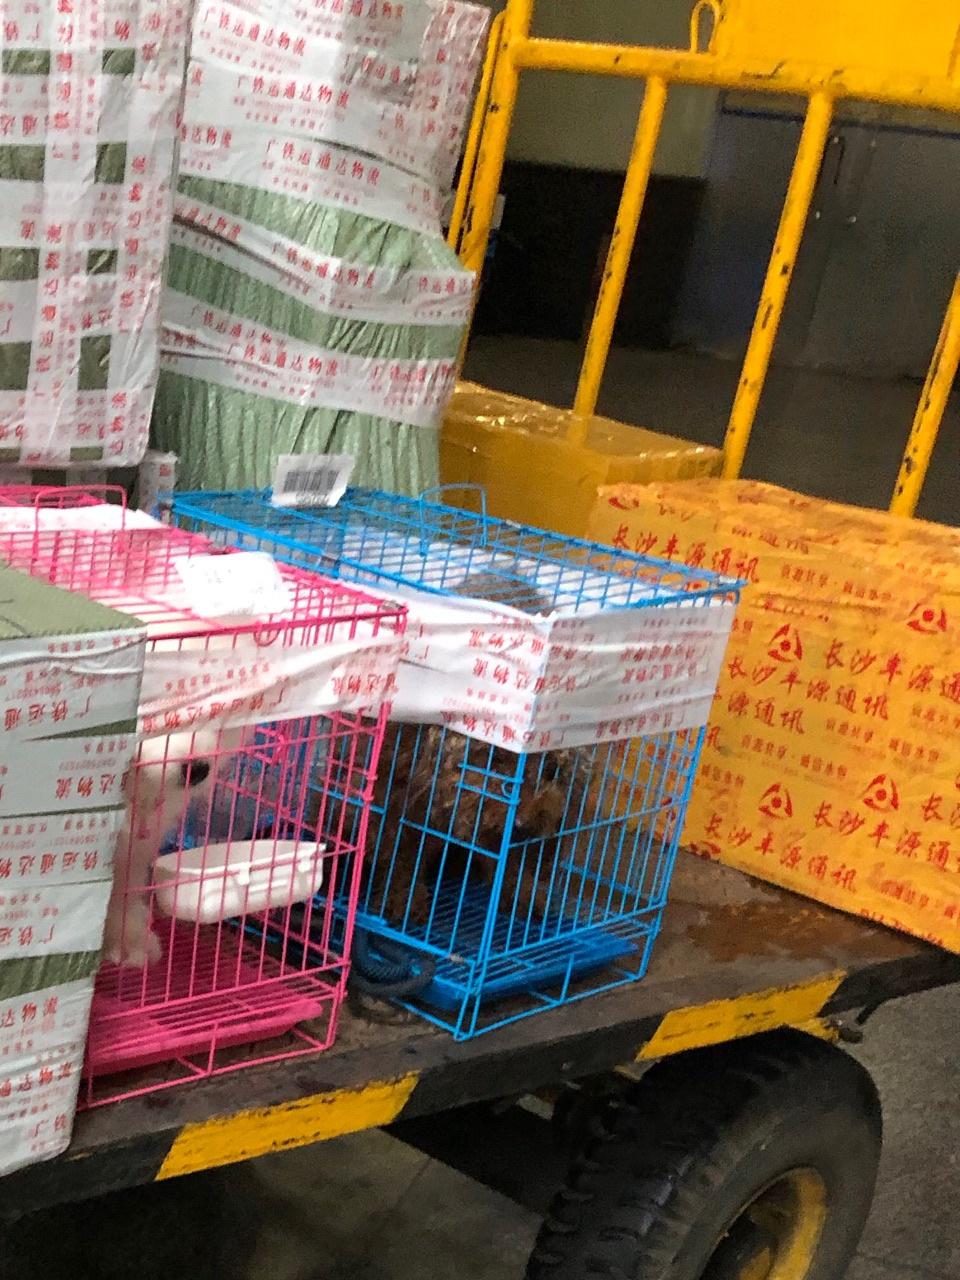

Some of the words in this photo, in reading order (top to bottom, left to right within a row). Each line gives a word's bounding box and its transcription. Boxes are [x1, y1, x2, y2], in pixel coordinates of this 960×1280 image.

[266, 138, 381, 186] 广铁运通达物流
